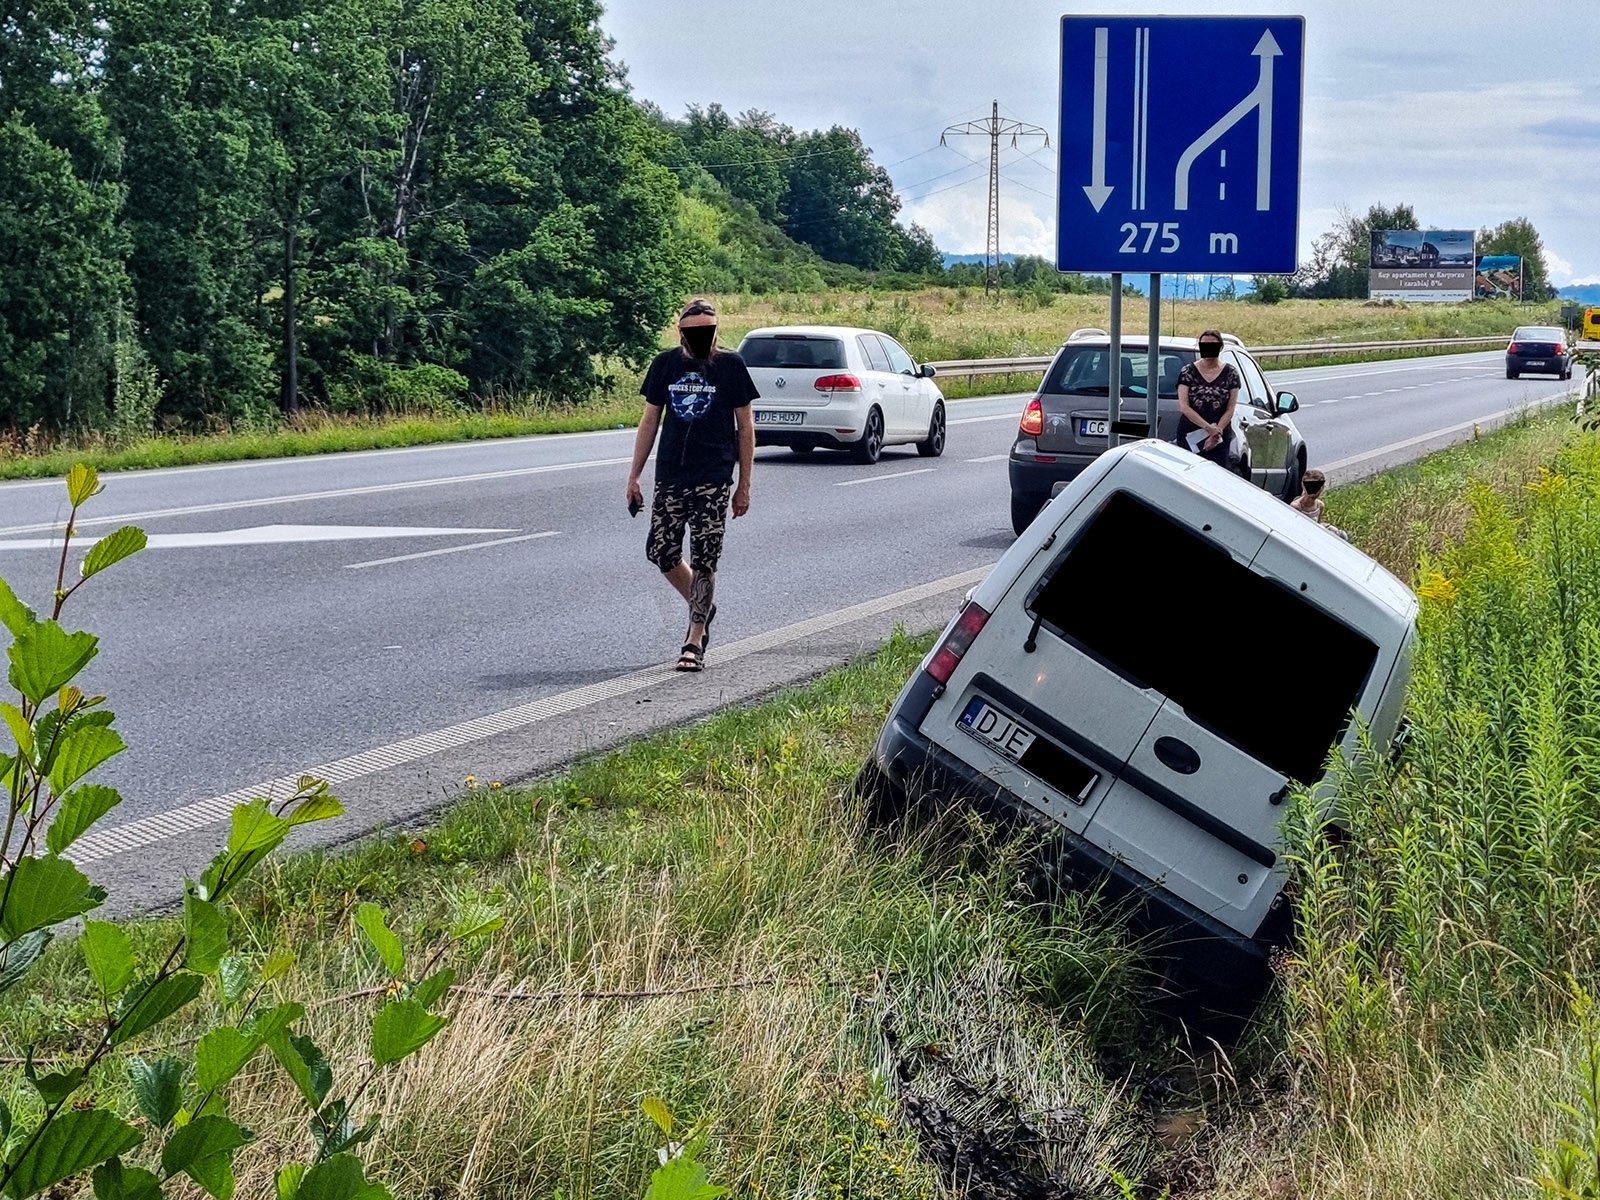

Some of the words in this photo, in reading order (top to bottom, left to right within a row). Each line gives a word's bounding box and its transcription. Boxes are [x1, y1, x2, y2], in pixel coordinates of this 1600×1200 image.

[1118, 222, 1180, 253] 275
[1209, 232, 1238, 254] m
[1391, 272, 1428, 280] apartament
[760, 412, 777, 421] DJE
[779, 412, 801, 421] HU37
[1089, 421, 1105, 434] CG
[976, 709, 1029, 755] DJE
